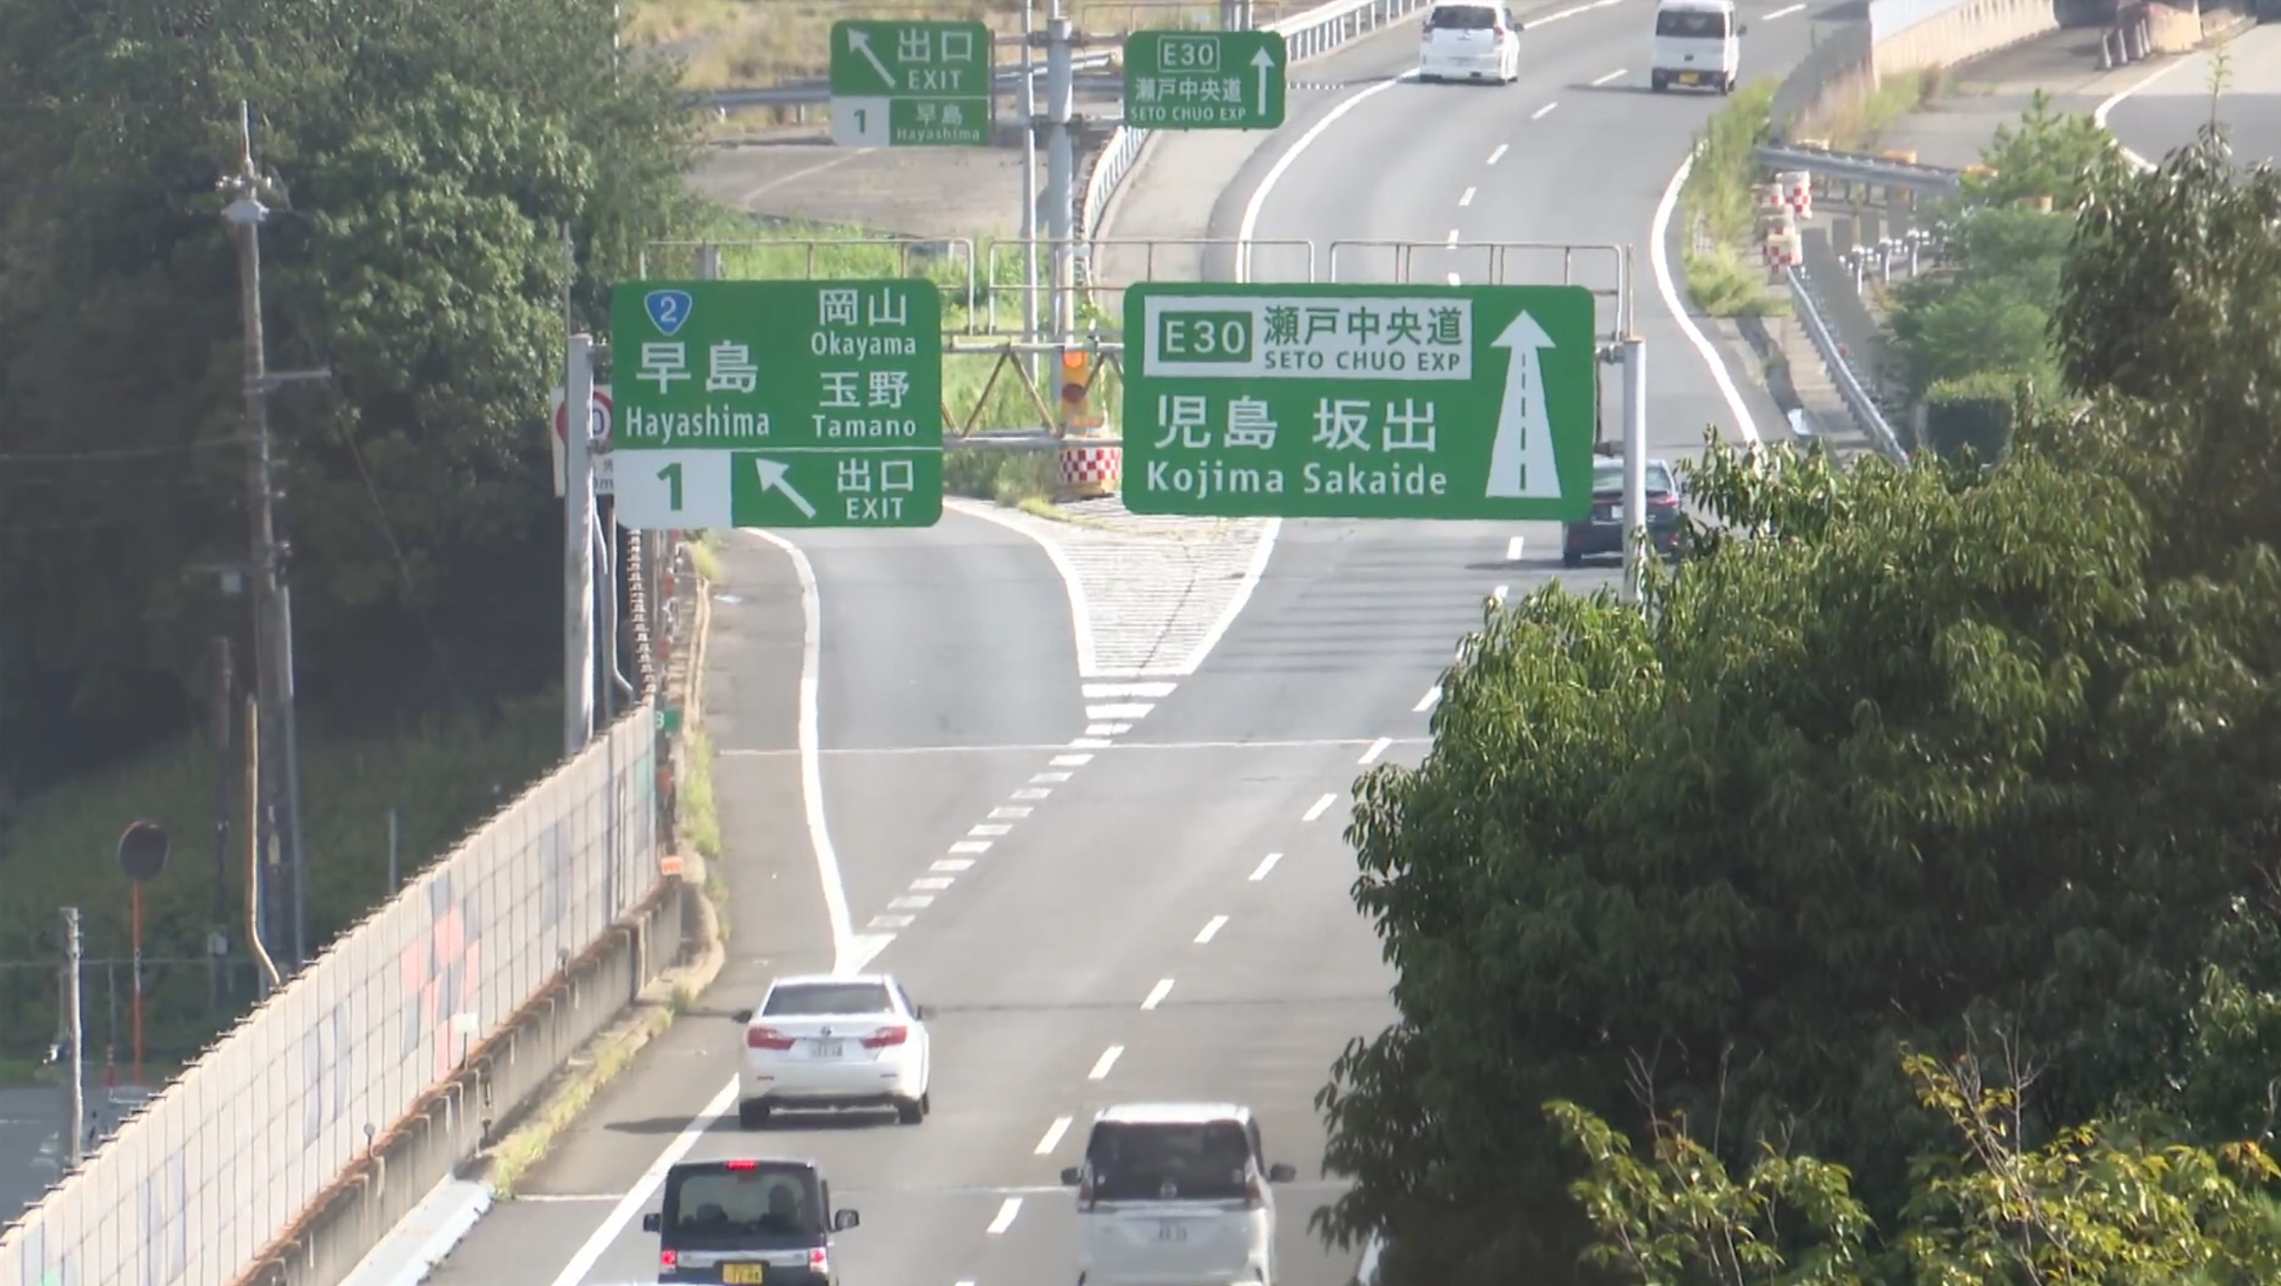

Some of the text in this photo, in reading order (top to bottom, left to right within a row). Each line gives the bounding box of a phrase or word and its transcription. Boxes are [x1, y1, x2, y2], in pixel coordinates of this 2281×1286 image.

[897, 28, 973, 64] 出口
[1163, 42, 1214, 67] E30
[908, 69, 963, 91] EXIT
[1135, 77, 1243, 103] 瀬戸中央道
[852, 108, 866, 134] 1
[916, 104, 963, 127] 早島
[1131, 106, 1247, 122] SETO CHUO EXP
[897, 127, 980, 143] Hayashima
[660, 296, 677, 323] 2
[818, 287, 907, 327] 岡山
[1165, 320, 1245, 354] E30
[1263, 304, 1463, 346] 瀬戸中央道
[810, 331, 917, 361] Okayama
[1264, 350, 1461, 372] SETO CHUO EXP
[636, 340, 758, 395] 早島
[819, 370, 910, 409] 玉野
[625, 405, 770, 445] Hayashima
[812, 414, 917, 438] Tamano
[1153, 395, 1437, 452] 児島 坂出
[655, 462, 683, 512] 1
[837, 457, 914, 493] 出口
[1147, 460, 1448, 500] Kojima Sakaide
[846, 498, 904, 520] EXIT
